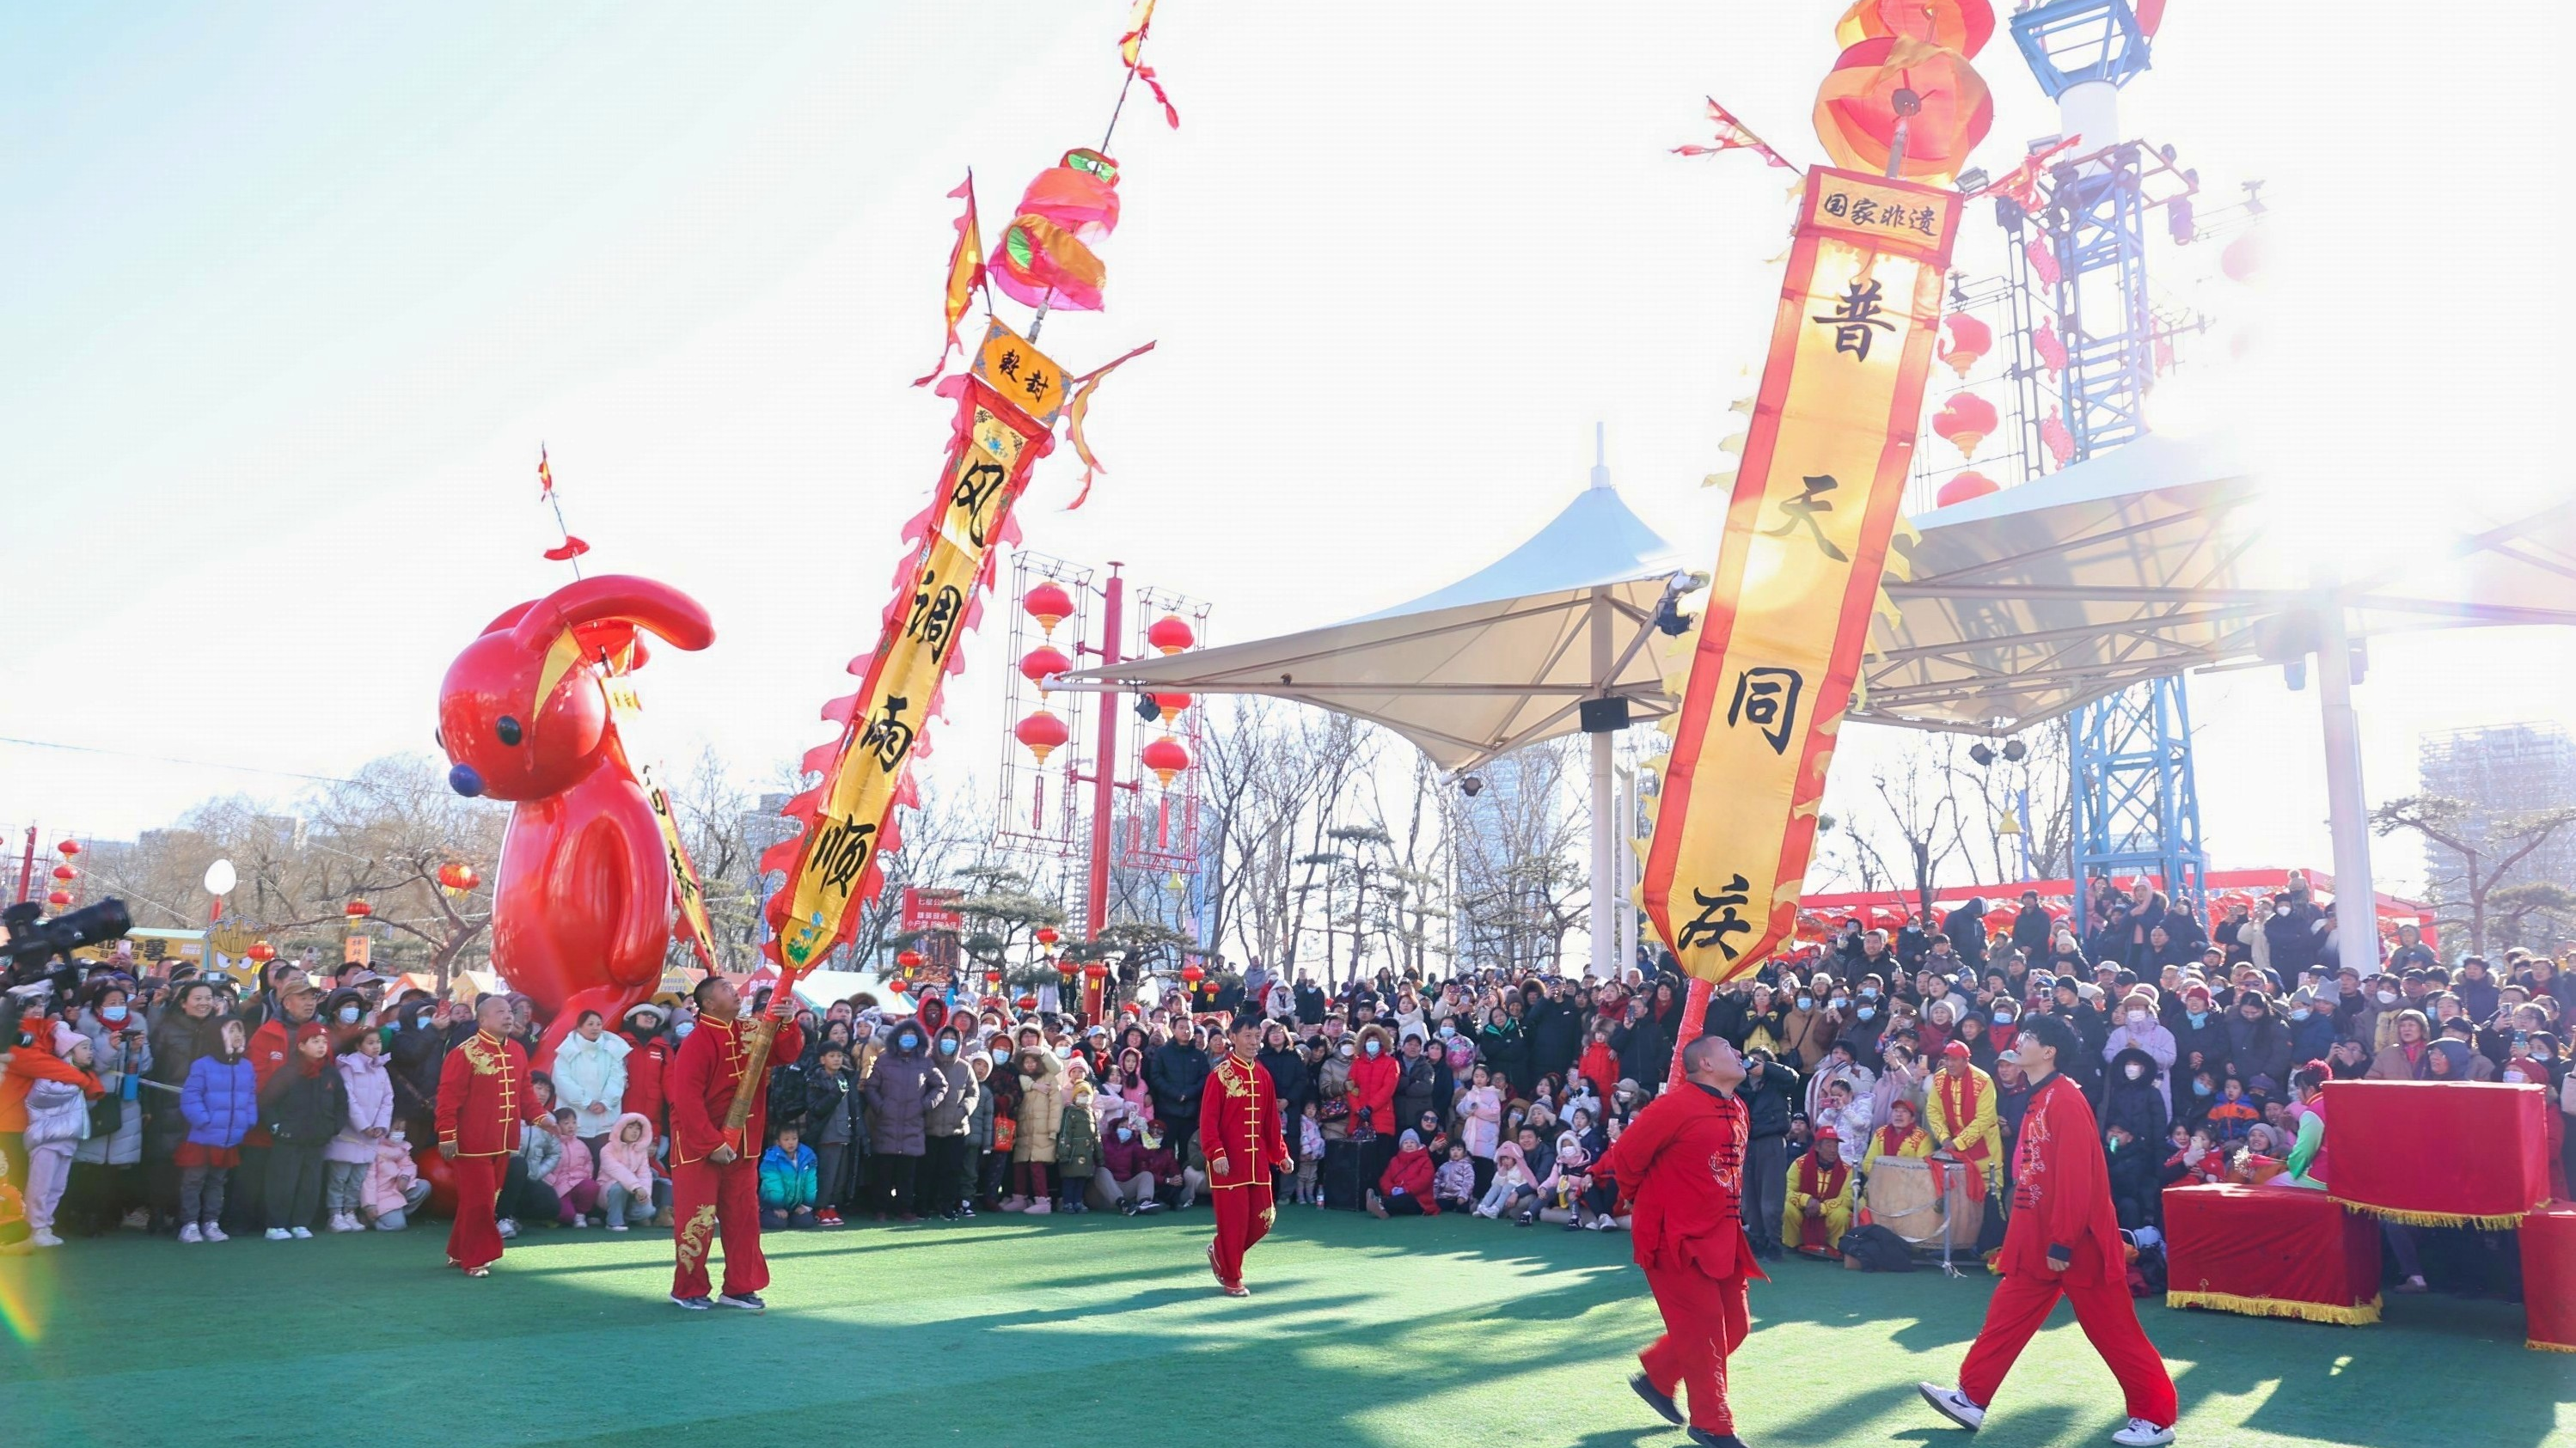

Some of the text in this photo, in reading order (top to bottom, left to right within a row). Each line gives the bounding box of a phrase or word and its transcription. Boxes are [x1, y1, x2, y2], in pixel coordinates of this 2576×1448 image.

[1824, 193, 1937, 236] 国家非遗
[811, 463, 1006, 899] 风调雨顺
[1677, 280, 1896, 962] 普天同庆
